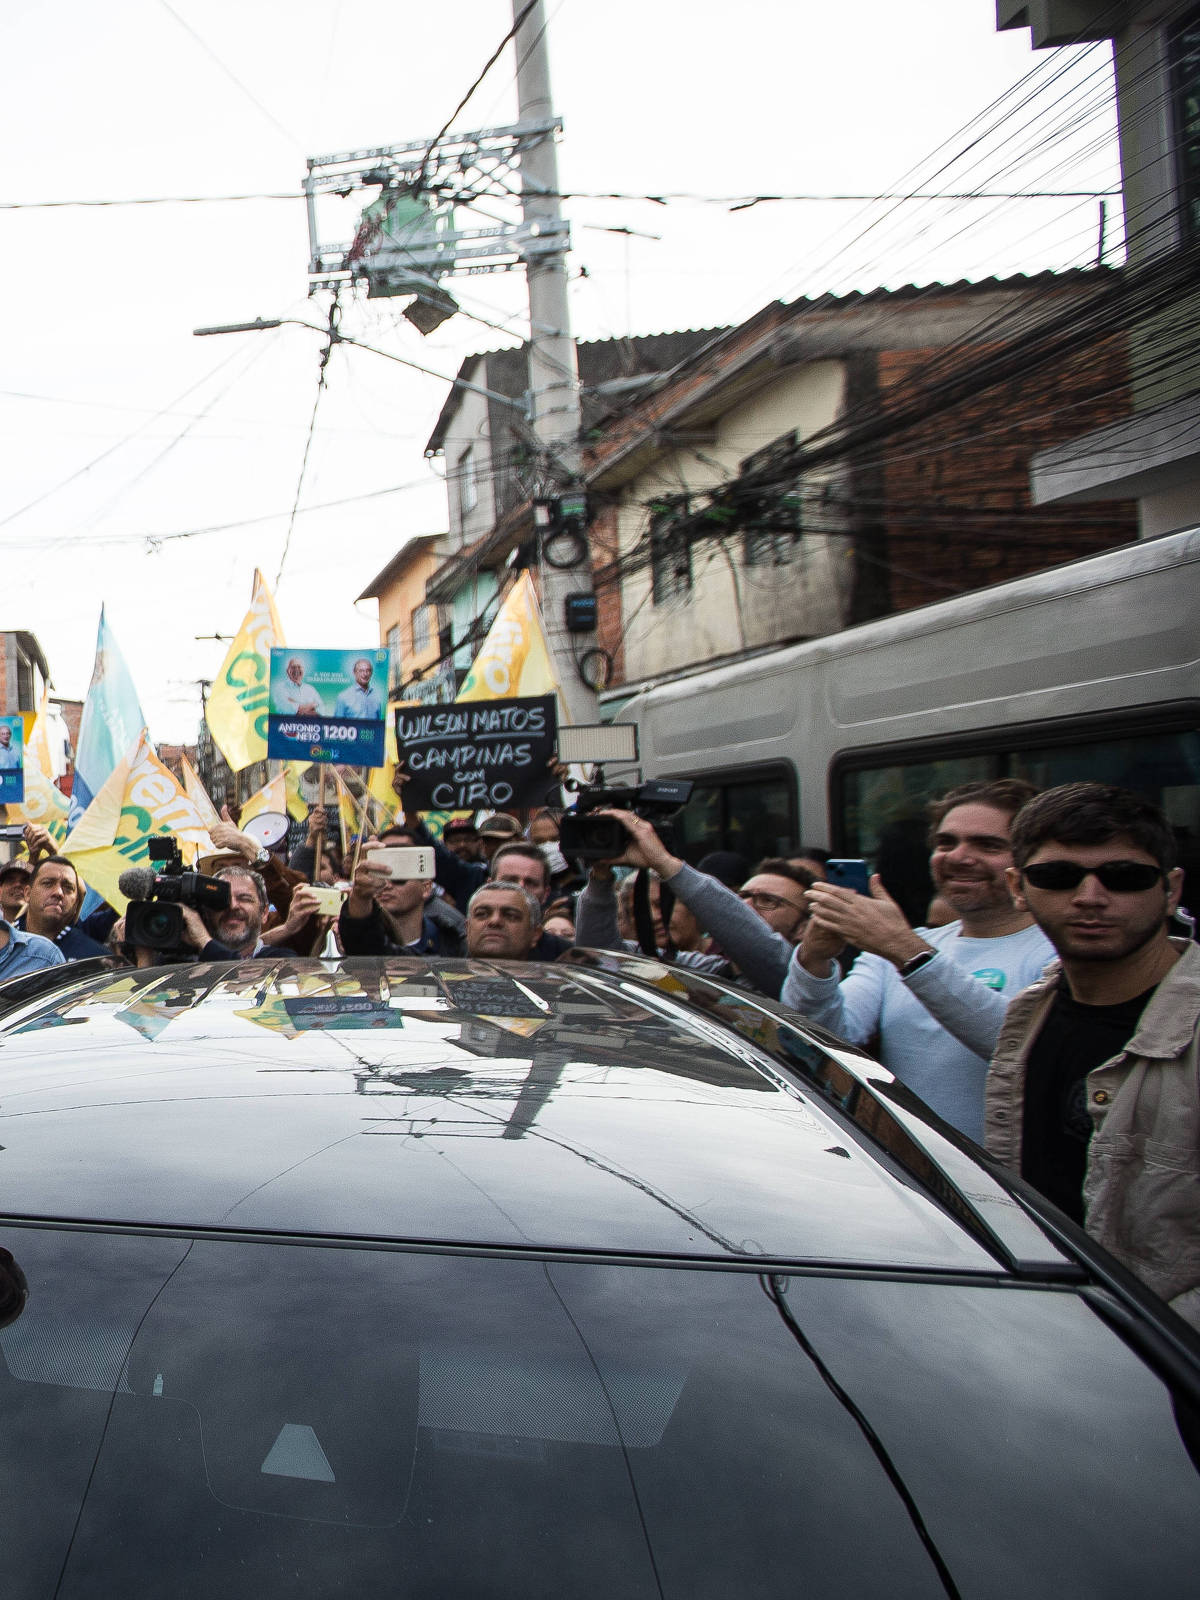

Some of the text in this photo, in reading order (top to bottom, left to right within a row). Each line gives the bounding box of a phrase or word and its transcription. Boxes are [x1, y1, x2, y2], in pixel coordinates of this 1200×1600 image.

[278, 722, 321, 734] ANTONIO
[323, 725, 357, 740] 1200
[398, 711, 468, 740] WILSON
[471, 707, 545, 732] MATOS
[296, 732, 321, 743] NETO
[408, 743, 532, 771] CAMPINAS
[431, 782, 513, 808] CIRO
